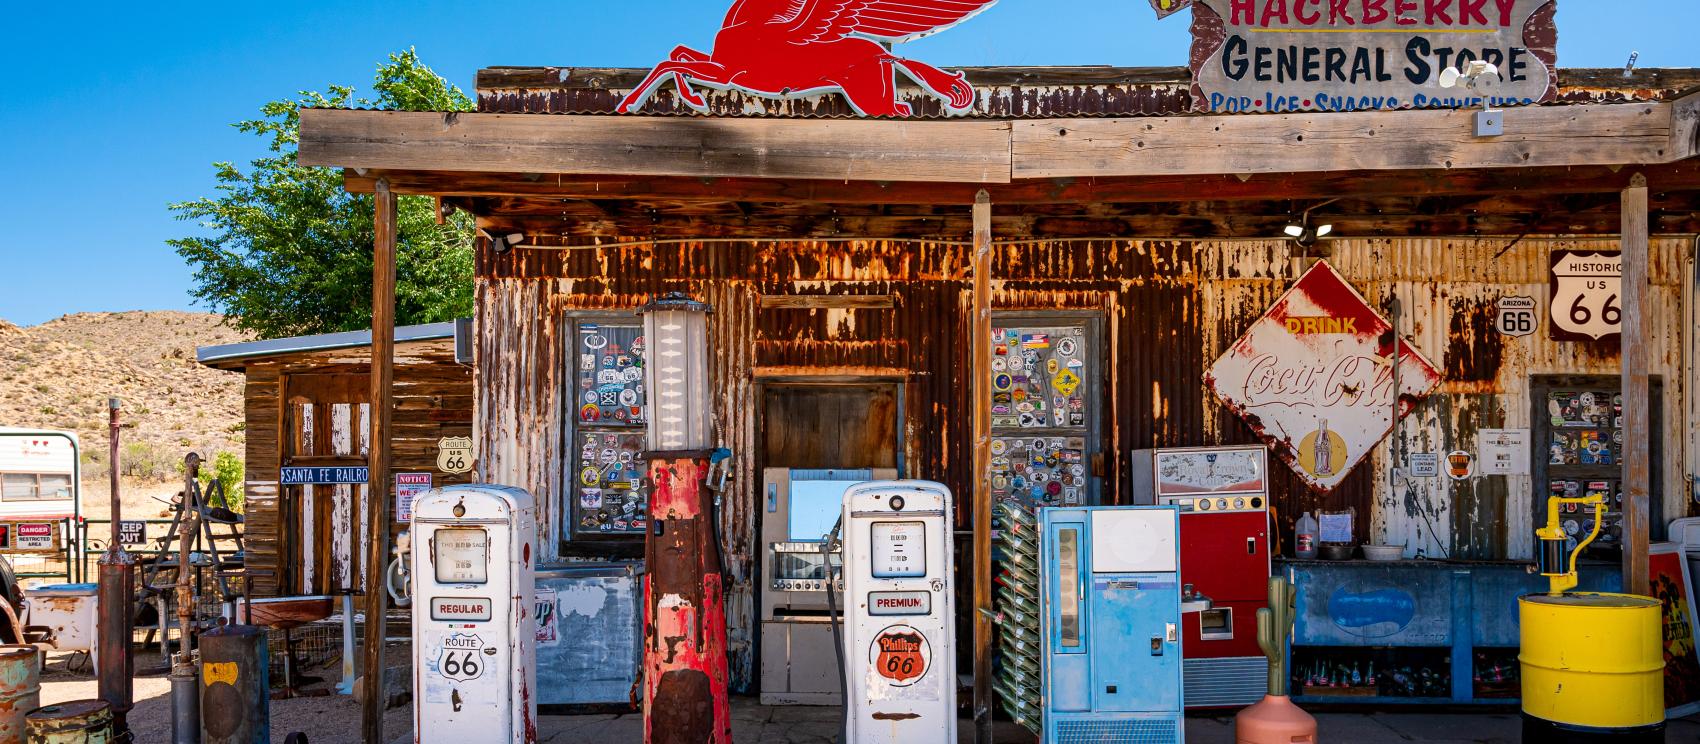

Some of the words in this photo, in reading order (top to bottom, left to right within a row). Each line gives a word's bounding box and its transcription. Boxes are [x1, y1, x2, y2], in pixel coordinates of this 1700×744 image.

[1230, 0, 1516, 27] HACKBERRY
[1222, 34, 1392, 84] GENERAL
[1404, 35, 1527, 85] STORE
[1211, 92, 1251, 113] POP
[1266, 91, 1299, 113] ICE
[1569, 263, 1622, 272] HISTORIC
[1586, 280, 1607, 290] US
[1569, 293, 1622, 326] 66
[1286, 316, 1358, 334] DRINK
[1503, 311, 1531, 332] 66
[445, 441, 468, 449] ROUTE
[446, 458, 465, 470] 66
[285, 468, 314, 482] SANTA
[319, 468, 331, 482] FE
[336, 468, 368, 482] RAILRO
[440, 604, 483, 614] REGULAR
[877, 598, 922, 608] PREMIUM
[445, 638, 477, 648] ROUTE
[881, 637, 918, 653] Phillips
[444, 651, 479, 676] 66
[887, 655, 915, 675] 66
